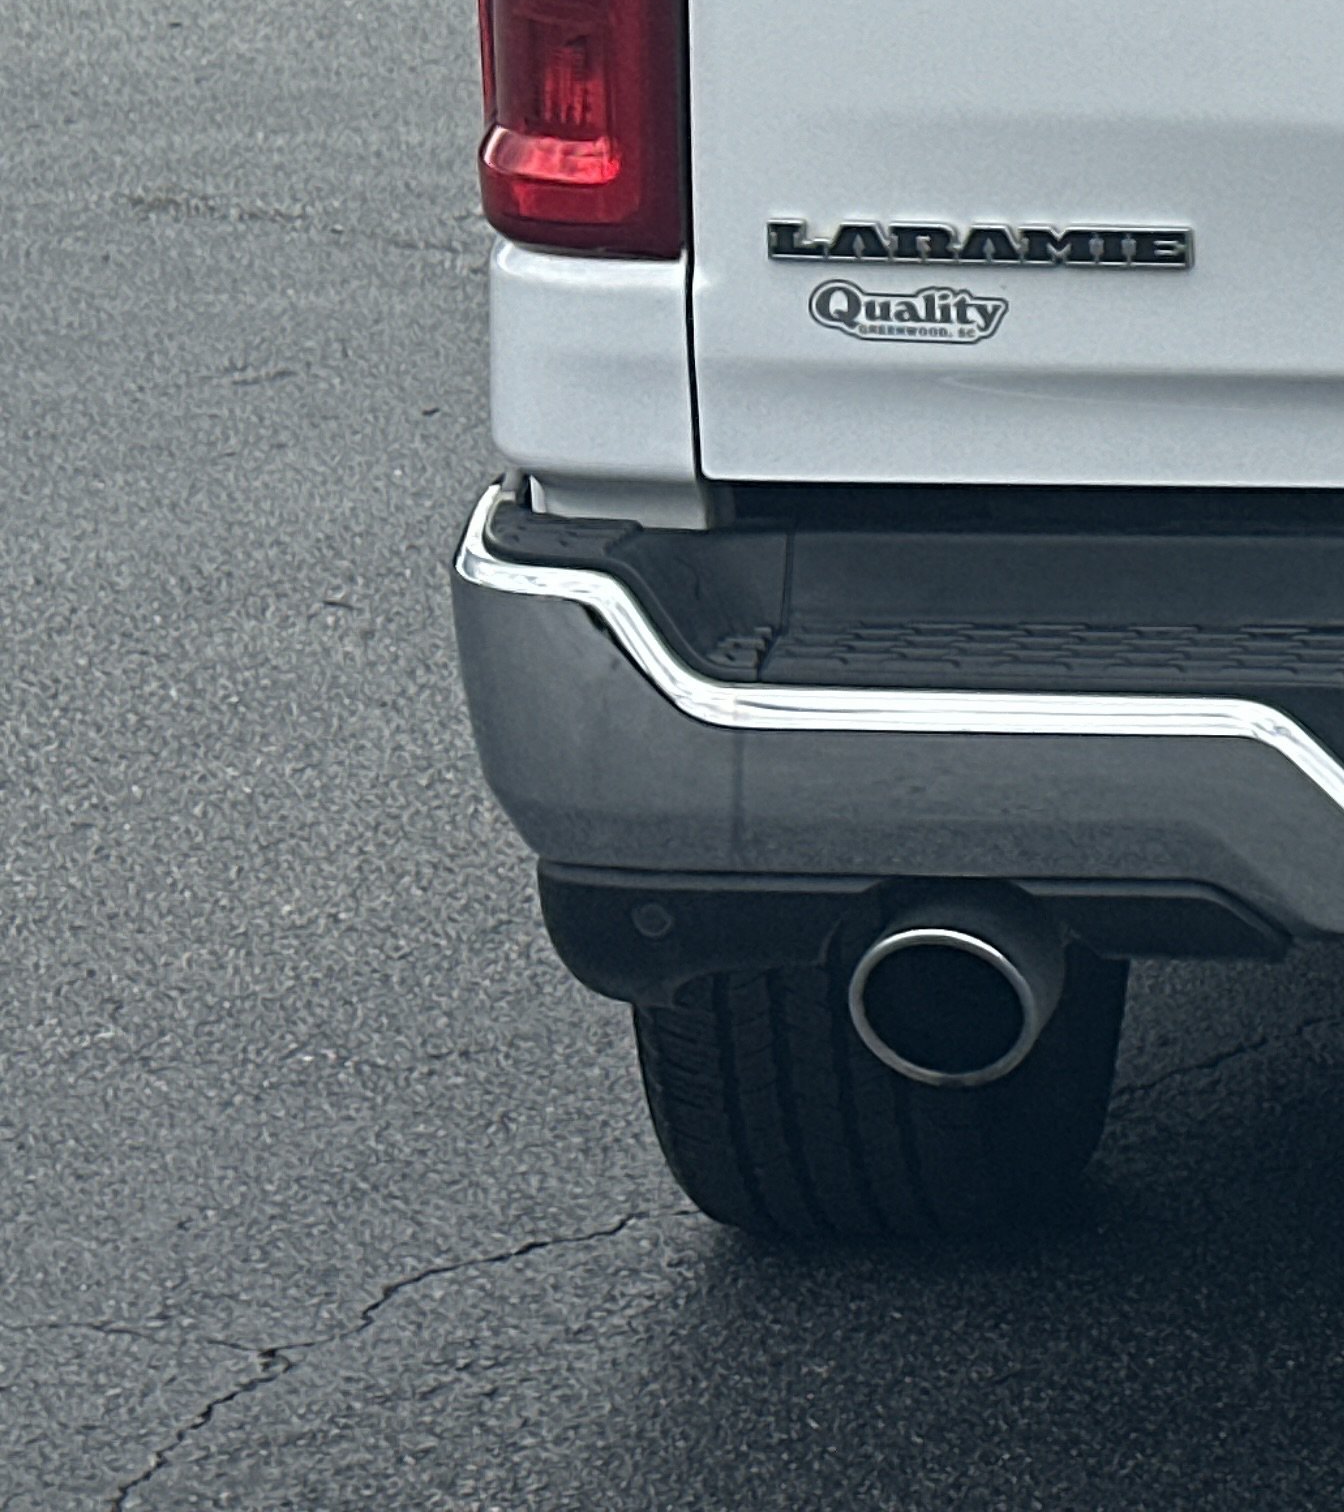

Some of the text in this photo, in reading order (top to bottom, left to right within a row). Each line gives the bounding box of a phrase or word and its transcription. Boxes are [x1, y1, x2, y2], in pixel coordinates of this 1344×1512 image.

[766, 218, 1194, 269] LARAMIE
[815, 287, 1002, 333] Quality
[858, 324, 977, 338] GREENWOOD, SC
